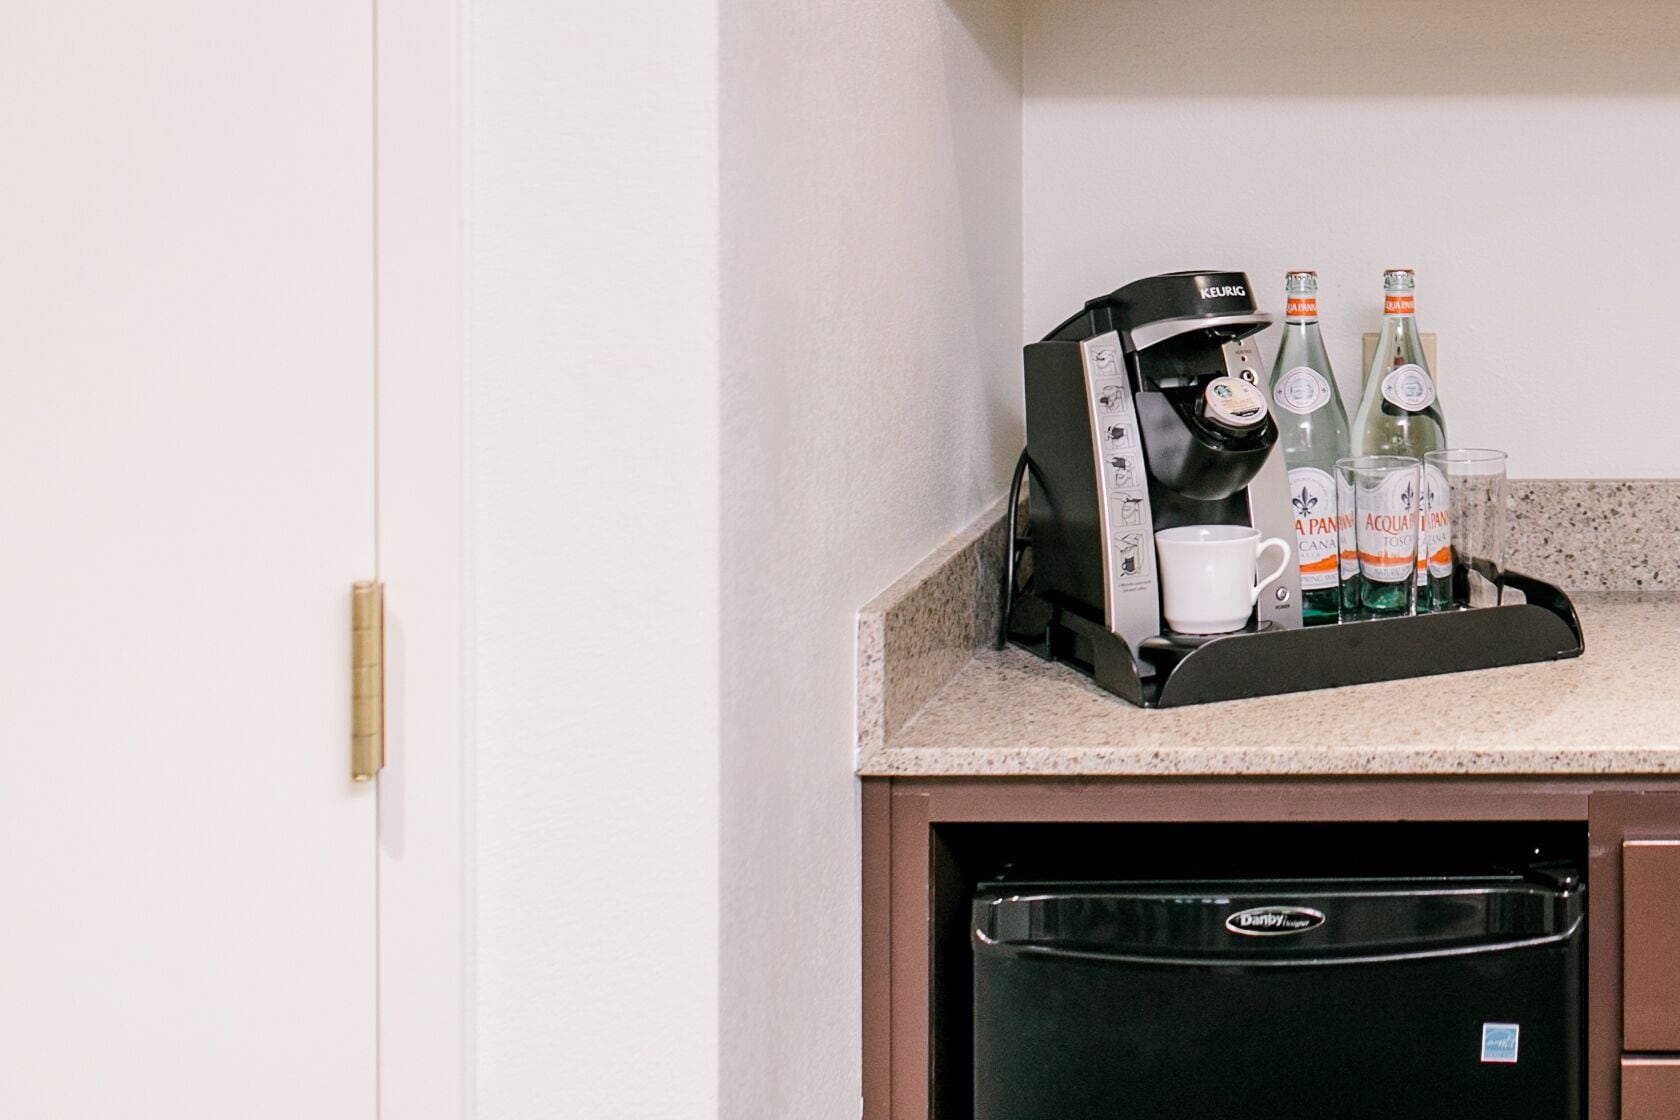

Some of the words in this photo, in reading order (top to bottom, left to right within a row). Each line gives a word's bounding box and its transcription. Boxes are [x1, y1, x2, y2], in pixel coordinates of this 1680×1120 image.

[1200, 285, 1246, 300] KEURIG
[1309, 517, 1337, 535] PAN
[1365, 513, 1408, 535] ACQUA
[1299, 539, 1337, 552] CANA
[1384, 535, 1411, 547] TOSC
[1239, 913, 1283, 927] Danby
